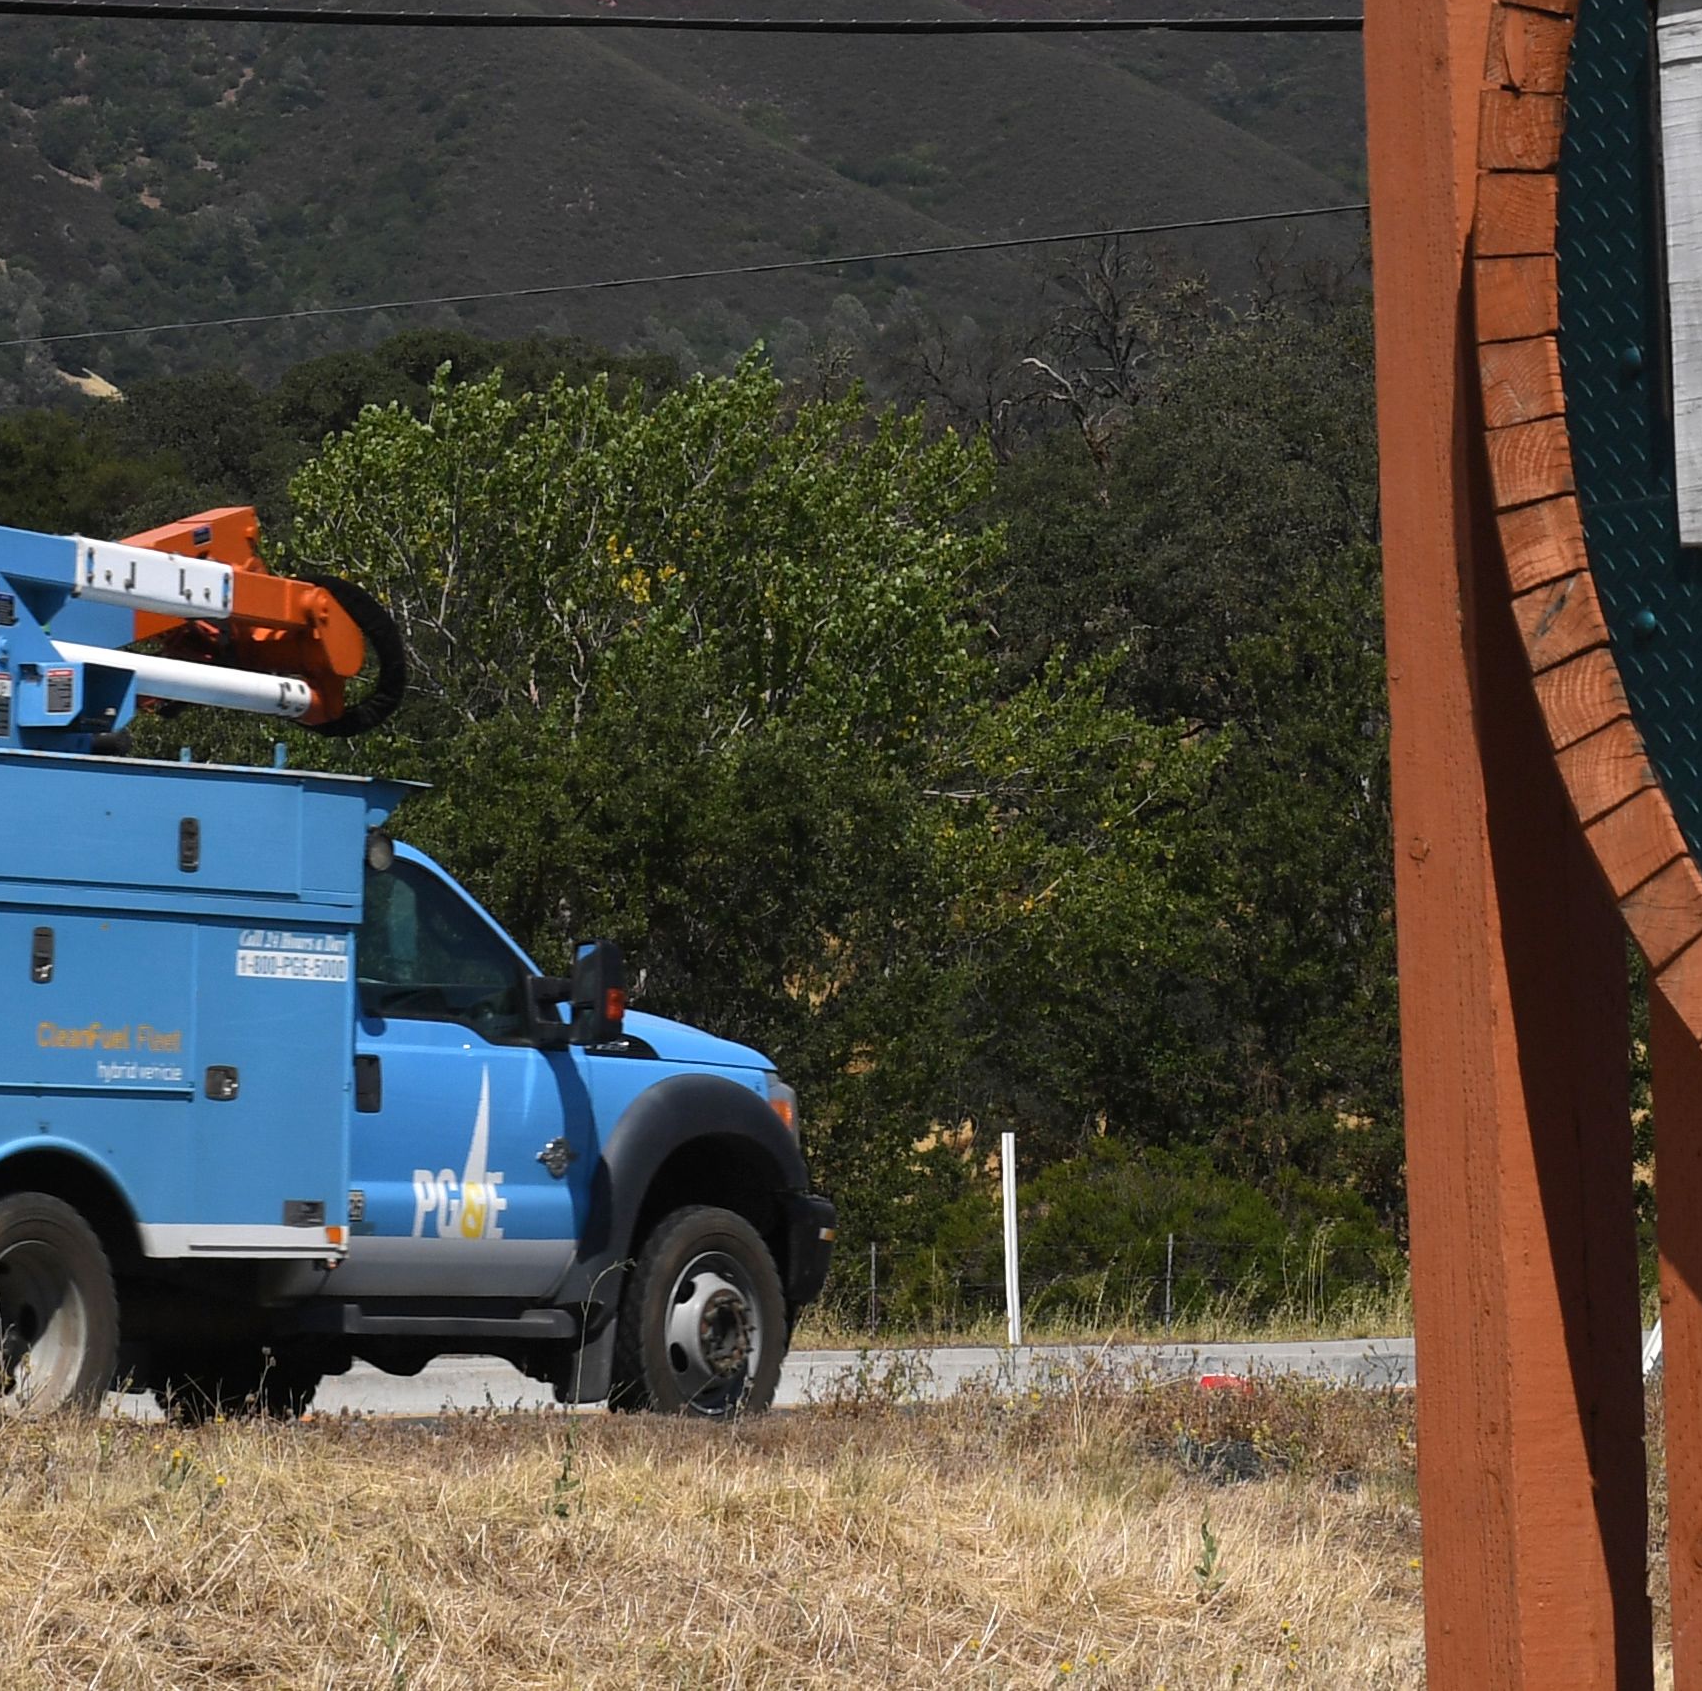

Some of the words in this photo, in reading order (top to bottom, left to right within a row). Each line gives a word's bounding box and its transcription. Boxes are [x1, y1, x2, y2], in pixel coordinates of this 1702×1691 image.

[239, 955, 345, 978] 1-800-PGE-5000
[137, 1023, 182, 1053] Fleet
[97, 1060, 138, 1082] hybrid
[139, 1062, 183, 1081] vehicle
[412, 1168, 507, 1239] PG&E
